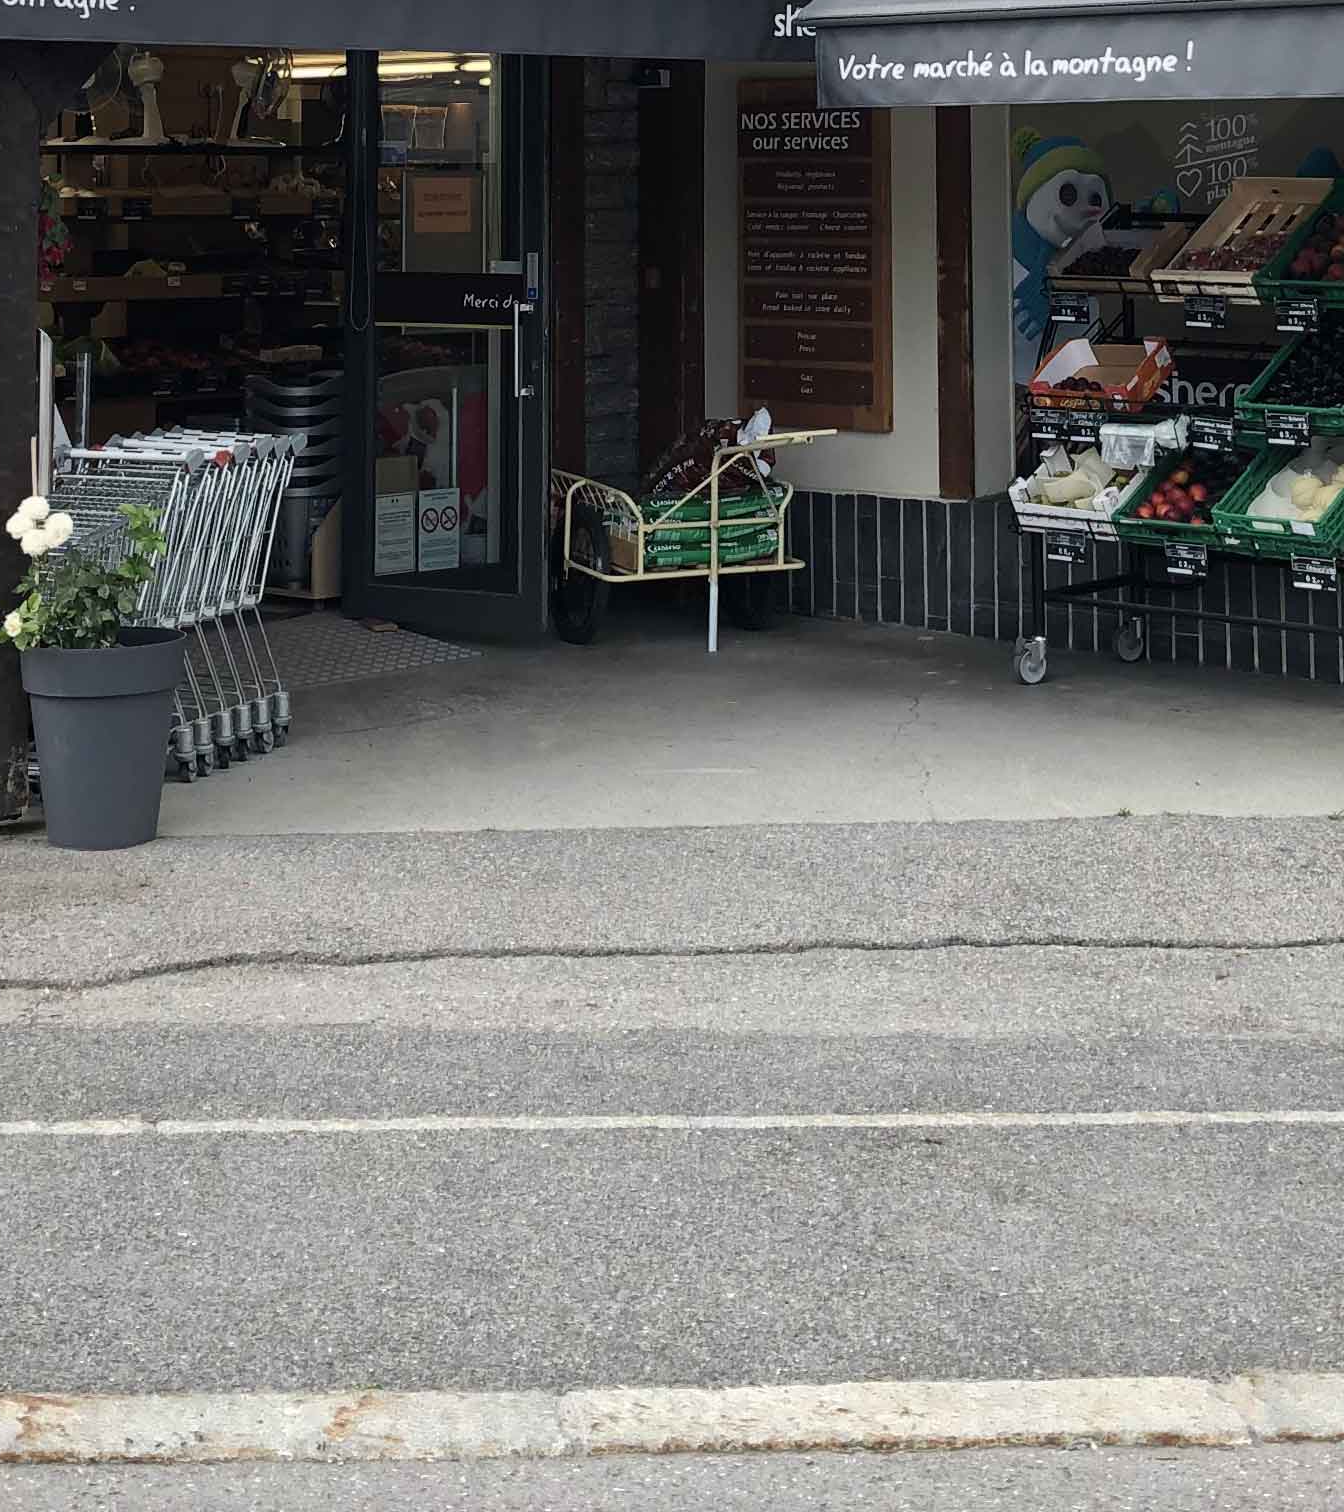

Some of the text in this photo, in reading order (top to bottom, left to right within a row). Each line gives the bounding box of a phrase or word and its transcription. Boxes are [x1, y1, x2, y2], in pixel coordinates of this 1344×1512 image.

[838, 54, 905, 81] Votre
[913, 50, 993, 79] marché
[999, 52, 1017, 78] à
[1024, 49, 1048, 76] la
[1052, 46, 1178, 82] montagne
[741, 111, 861, 130] NOS SERVICES
[752, 132, 849, 150] our services
[463, 293, 499, 309] Merci
